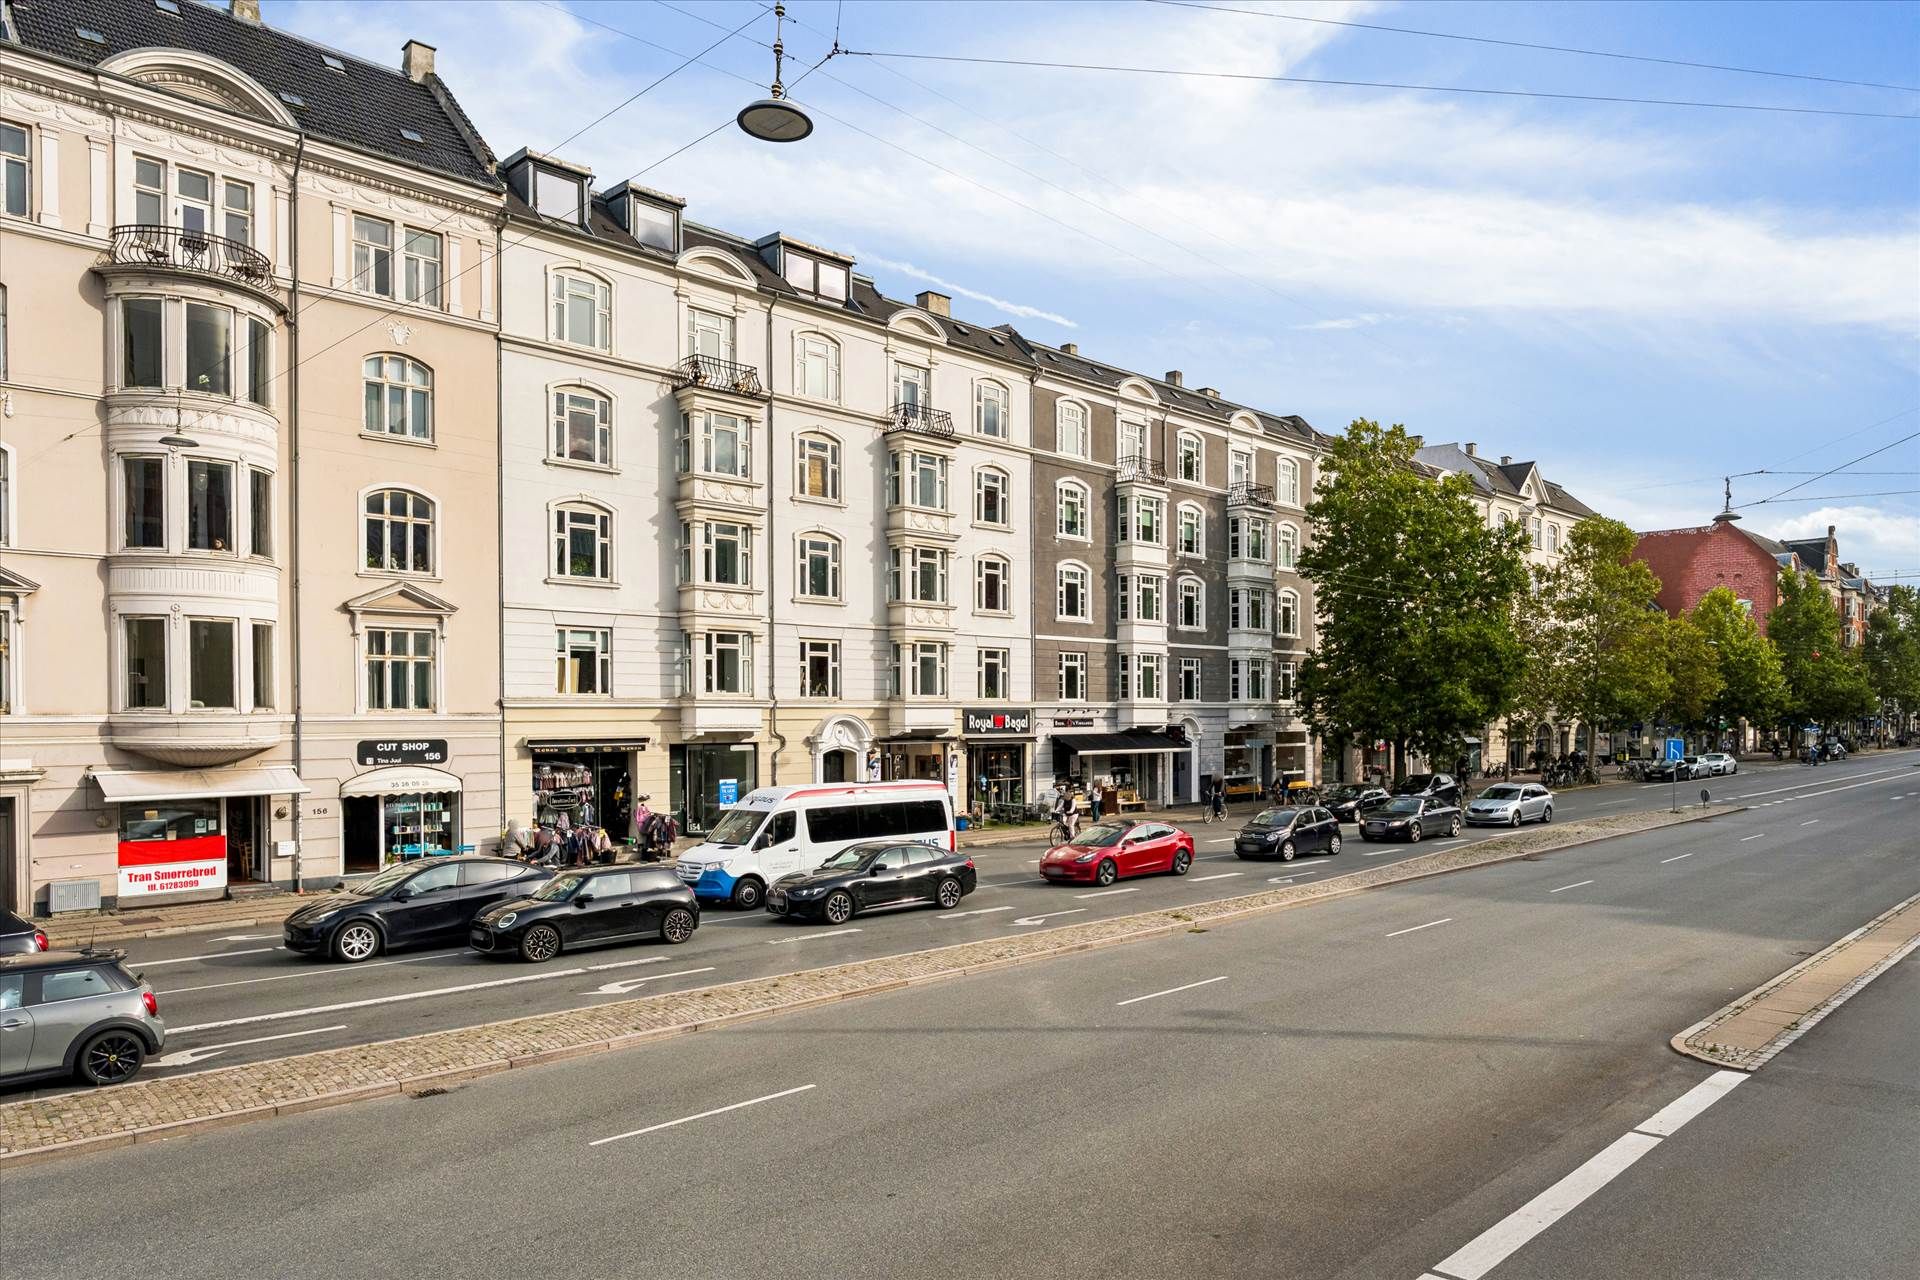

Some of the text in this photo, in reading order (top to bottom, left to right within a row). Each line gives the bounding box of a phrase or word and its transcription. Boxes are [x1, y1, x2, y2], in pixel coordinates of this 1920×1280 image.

[969, 714, 1029, 733] Royal Bagel
[376, 742, 430, 751] CUT SHOP
[424, 752, 441, 761] 156
[312, 807, 328, 815] 156
[689, 823, 701, 831] 154
[127, 866, 217, 883] Tran Smørrebrød
[159, 879, 199, 891] 61283099
